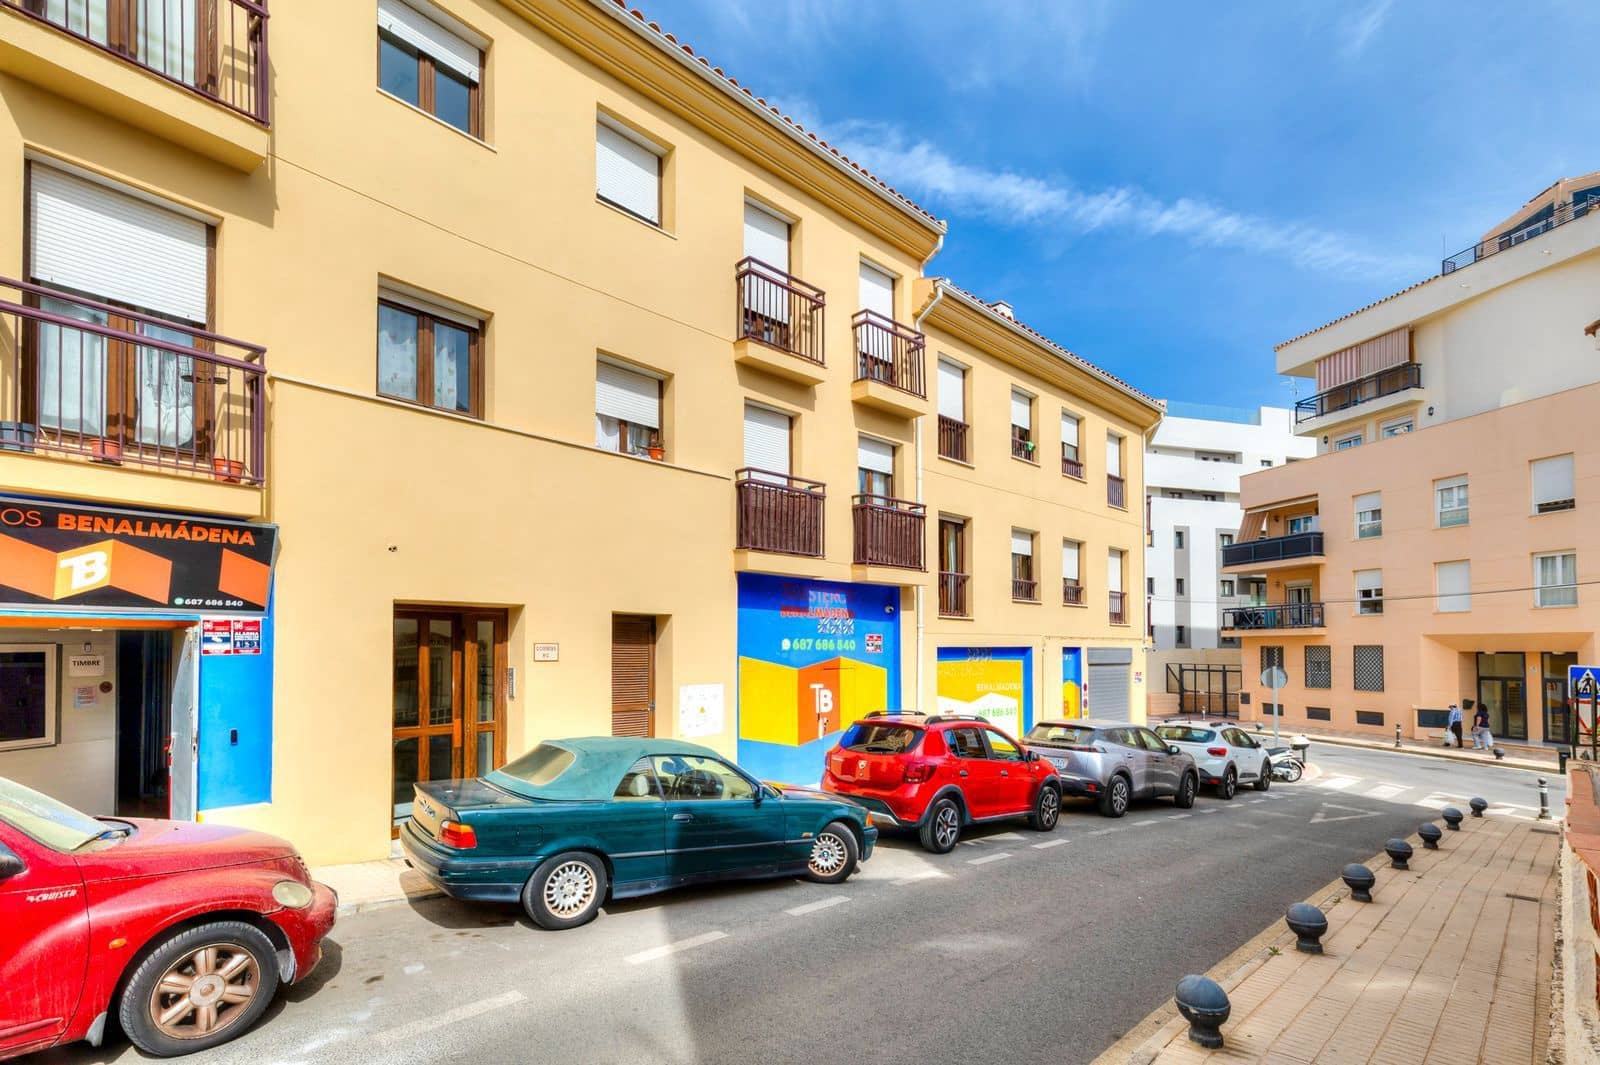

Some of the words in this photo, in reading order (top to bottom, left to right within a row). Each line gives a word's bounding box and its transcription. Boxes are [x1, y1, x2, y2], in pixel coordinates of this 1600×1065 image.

[1, 509, 42, 527] OS
[58, 513, 256, 546] BENALMÁDENA
[185, 598, 203, 606] 687
[205, 599, 223, 607] 686
[793, 639, 814, 651] 687
[815, 639, 835, 651] 686
